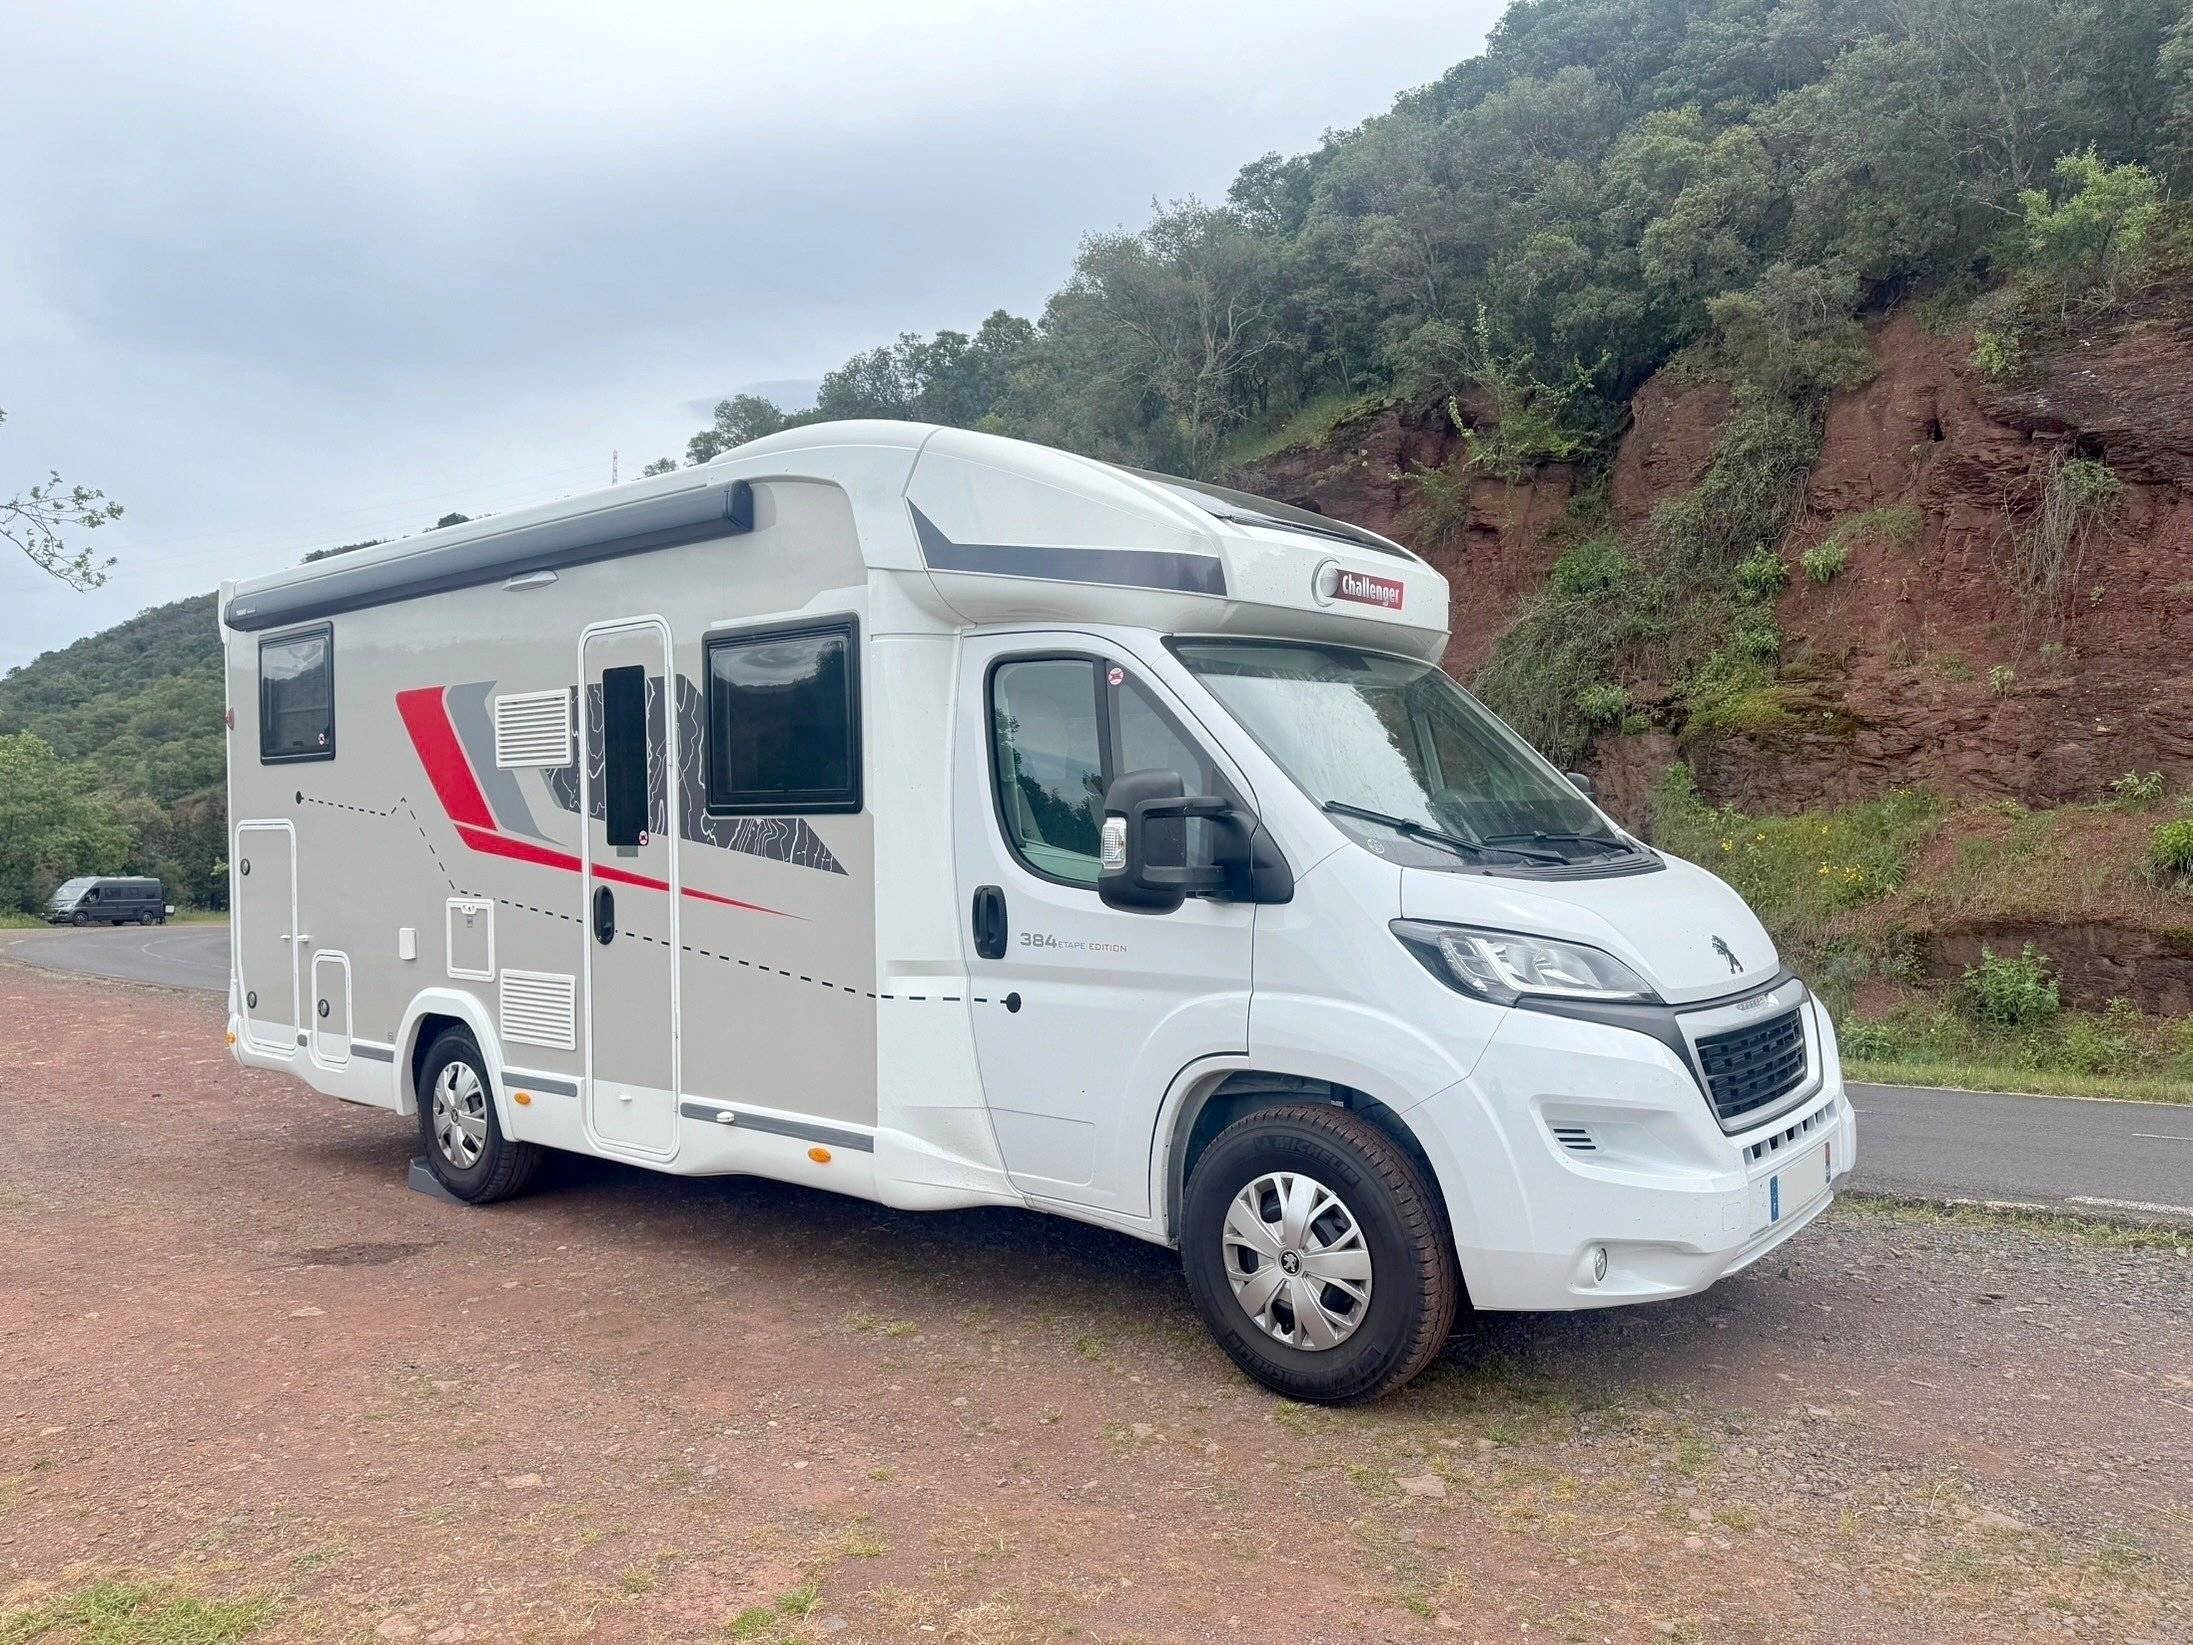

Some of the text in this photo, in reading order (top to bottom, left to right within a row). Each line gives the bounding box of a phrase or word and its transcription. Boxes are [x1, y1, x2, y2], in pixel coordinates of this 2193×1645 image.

[1342, 573, 1400, 606] Challenger
[1020, 932, 1127, 952] 384 ETAPE EDITION
